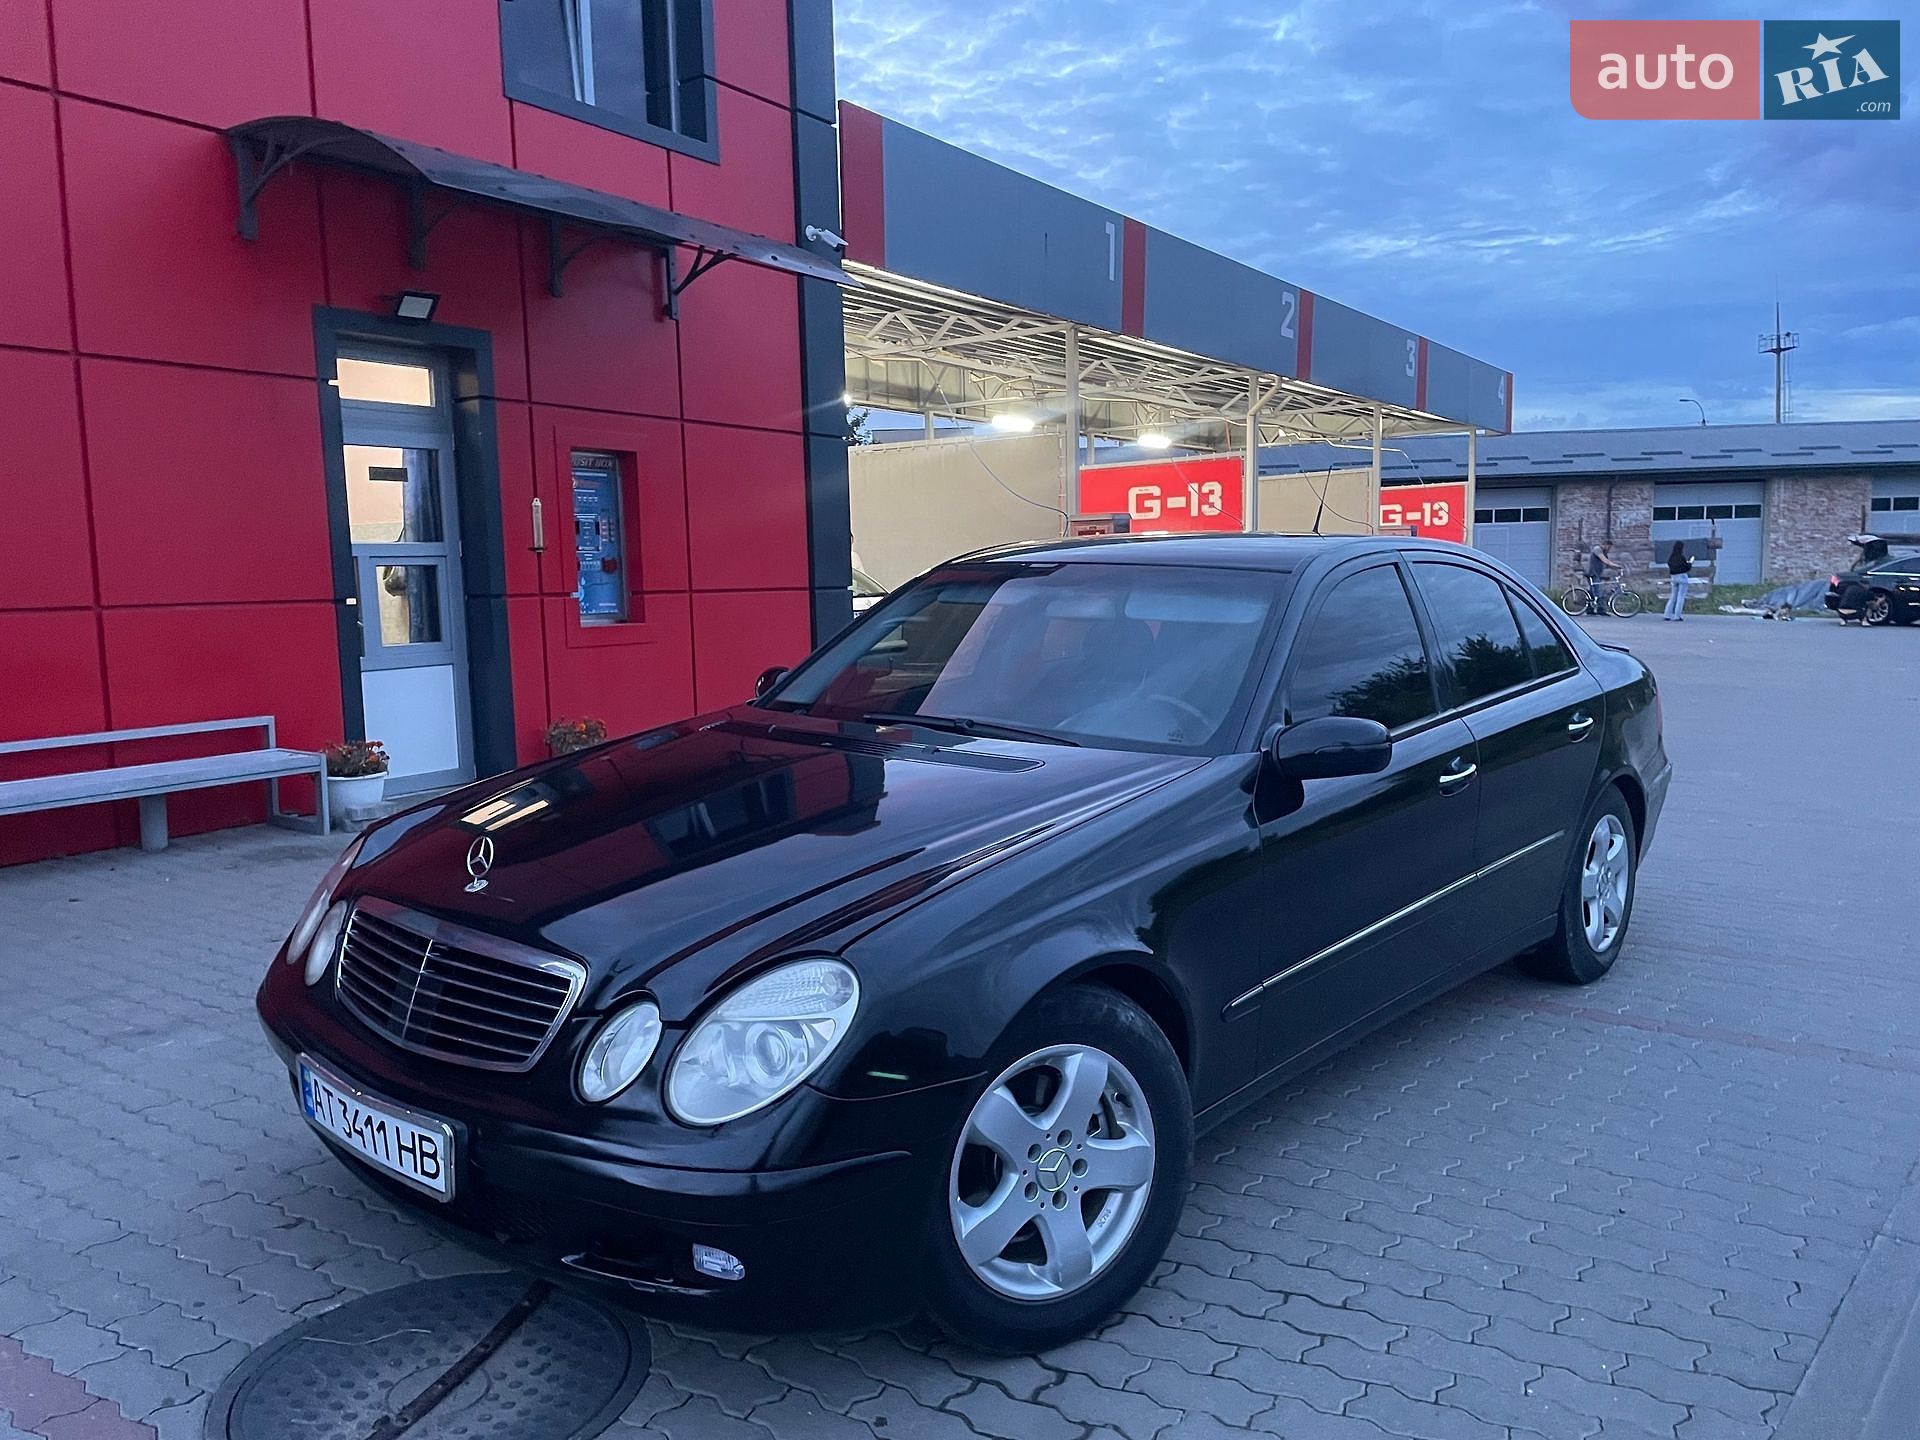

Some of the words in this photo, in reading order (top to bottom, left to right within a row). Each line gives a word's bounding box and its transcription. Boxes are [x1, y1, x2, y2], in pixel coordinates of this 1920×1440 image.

[1105, 221, 1116, 281] 1
[1280, 291, 1295, 339] 2
[1406, 339, 1416, 377] 3
[1498, 375, 1504, 406] 4
[1127, 481, 1224, 520] G-13
[1380, 502, 1449, 526] G-13
[313, 1079, 334, 1127] AT
[337, 1098, 390, 1161] 3411
[396, 1126, 440, 1180] HB
